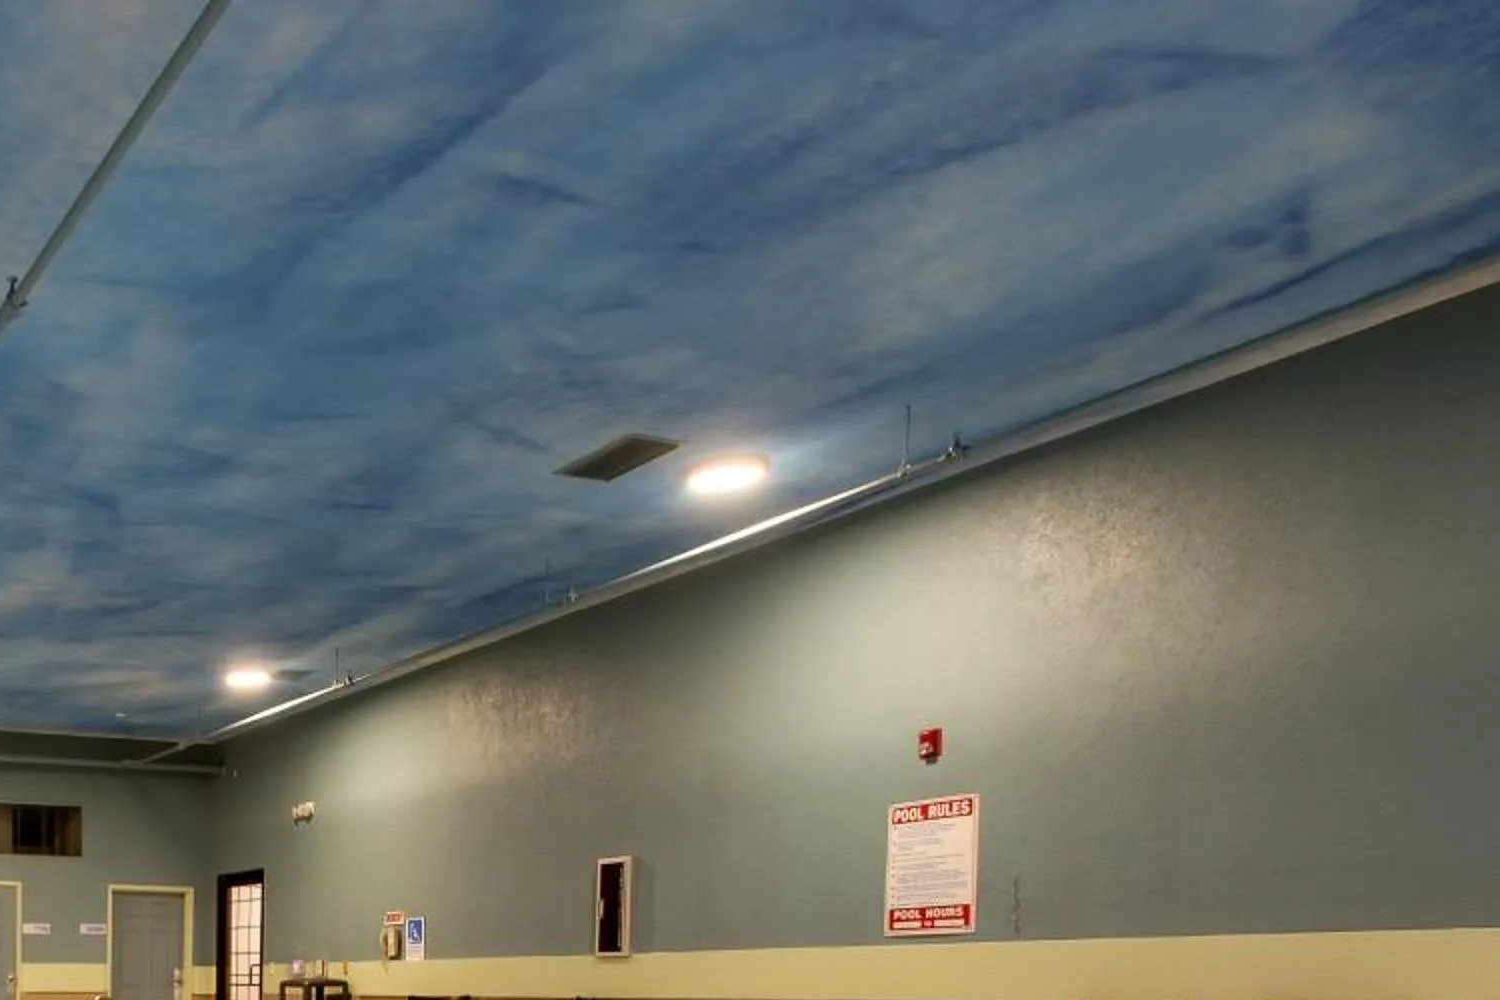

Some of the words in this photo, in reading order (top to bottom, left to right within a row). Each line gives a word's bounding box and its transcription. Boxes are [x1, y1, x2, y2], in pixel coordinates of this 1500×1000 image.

[893, 806, 925, 823] POOL
[928, 801, 971, 818] RULES
[893, 908, 923, 921] POOL
[925, 906, 964, 919] HOURS
